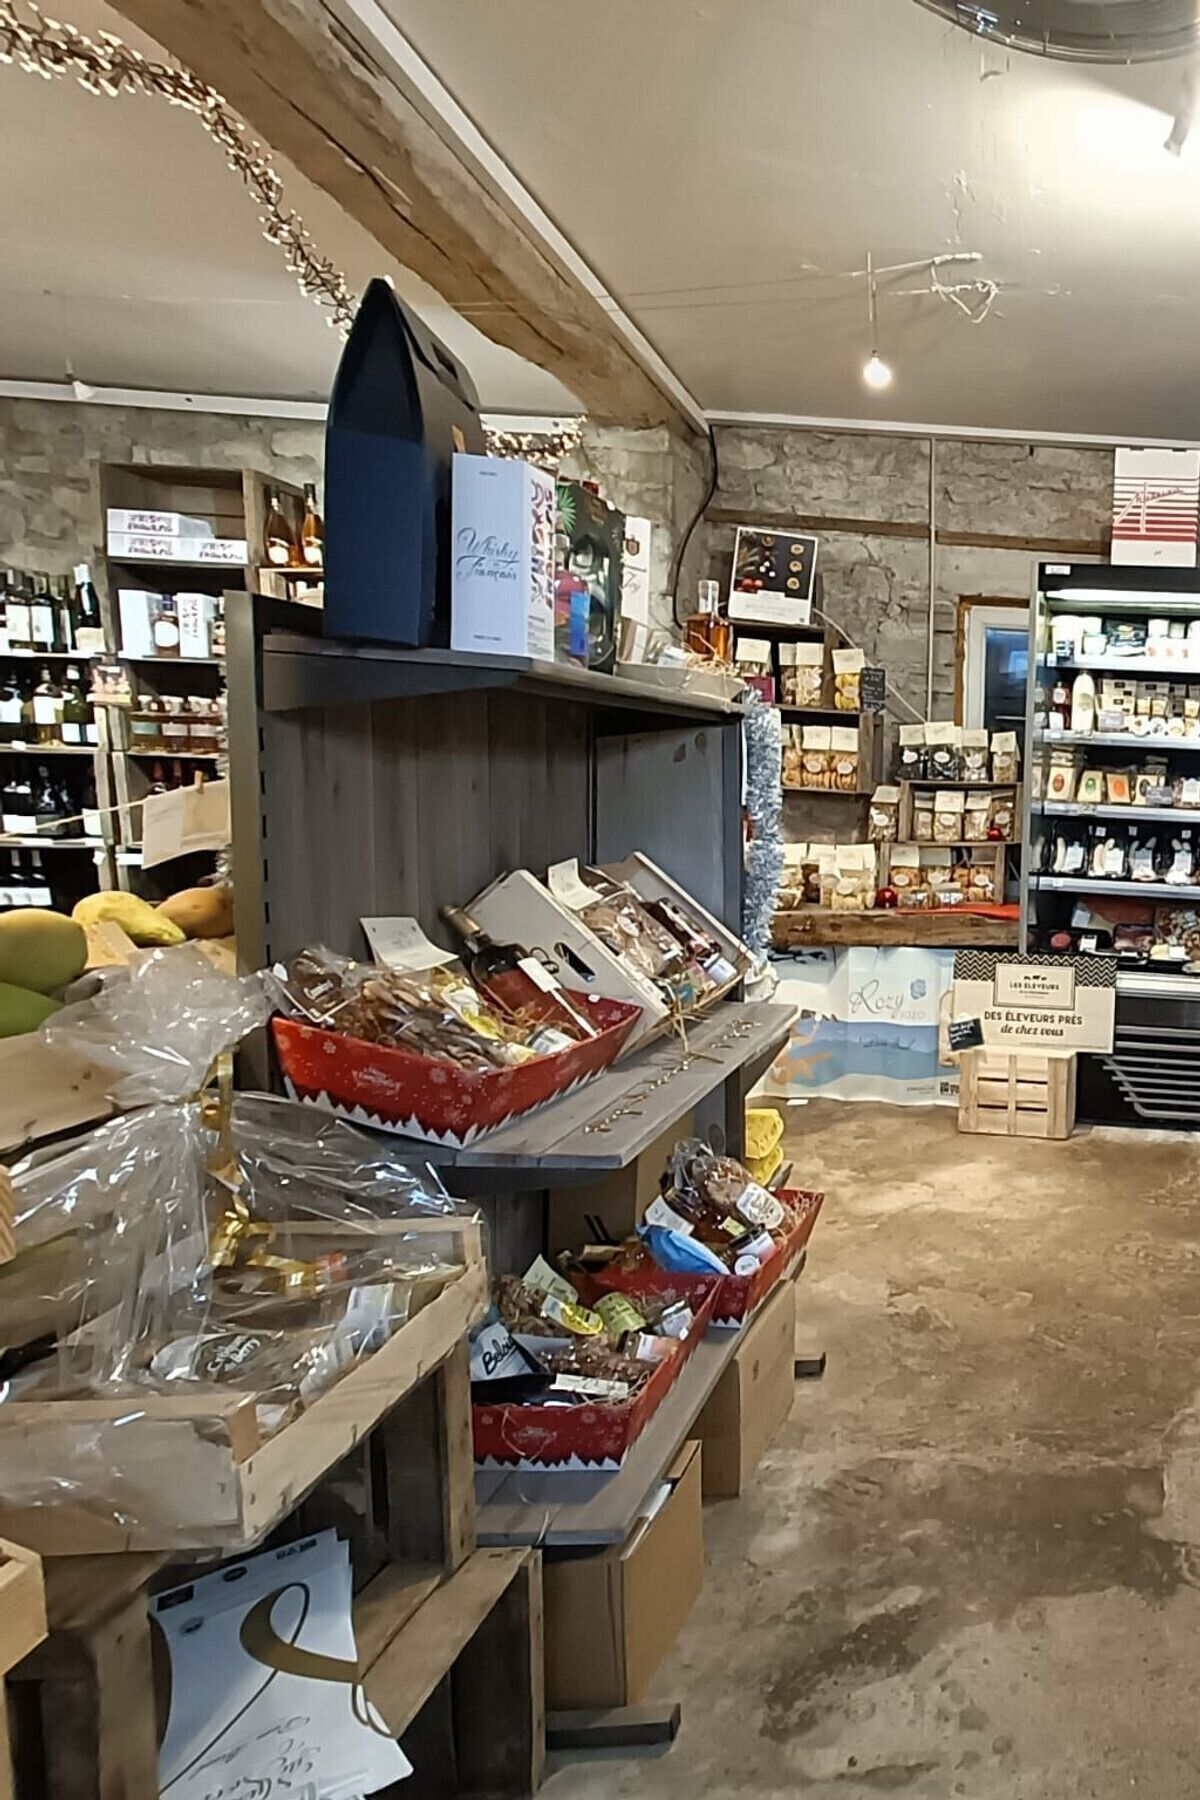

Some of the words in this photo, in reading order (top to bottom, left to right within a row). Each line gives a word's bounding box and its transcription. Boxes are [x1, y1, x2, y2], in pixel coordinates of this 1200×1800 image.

[456, 527, 519, 562] Whisky
[456, 555, 518, 581] Français
[984, 1011, 1002, 1020] DES
[1005, 1009, 1055, 1024] ÉLEVEURS
[1001, 1024, 1012, 1035] de
[1015, 1025, 1039, 1036] chez
[1041, 1028, 1064, 1037] vous
